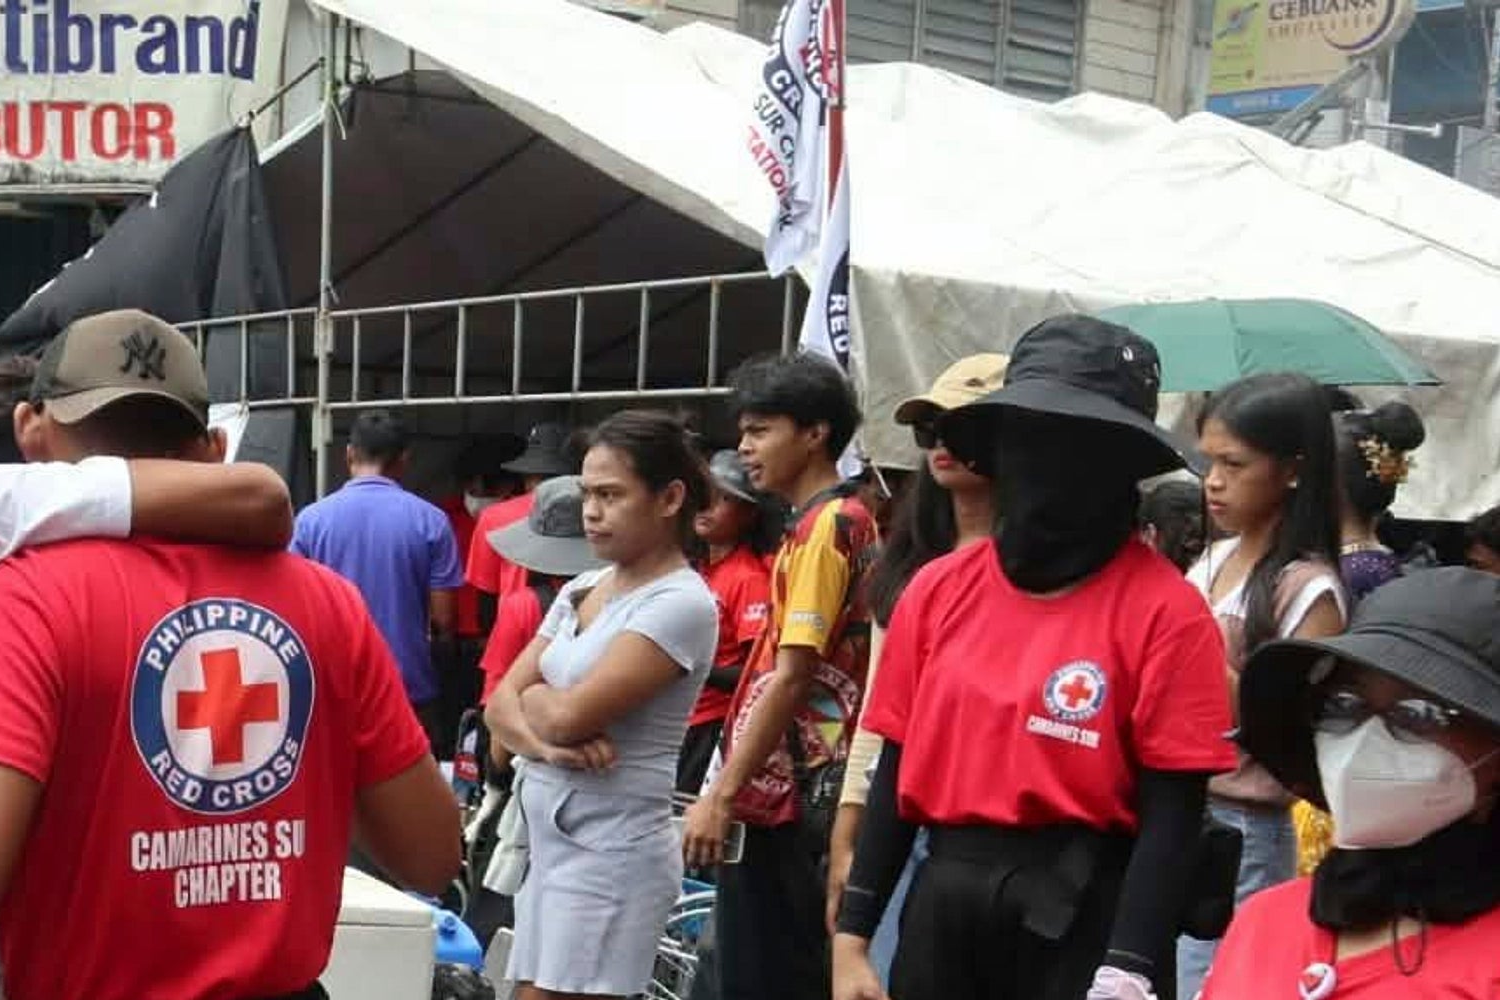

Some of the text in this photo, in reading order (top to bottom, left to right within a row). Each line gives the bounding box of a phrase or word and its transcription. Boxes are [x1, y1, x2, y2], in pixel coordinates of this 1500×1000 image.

[753, 93, 786, 134] SUR
[151, 737, 299, 808] RED CROSS
[131, 819, 306, 871] CAMARINES SU
[175, 862, 281, 908] CHAPTER
